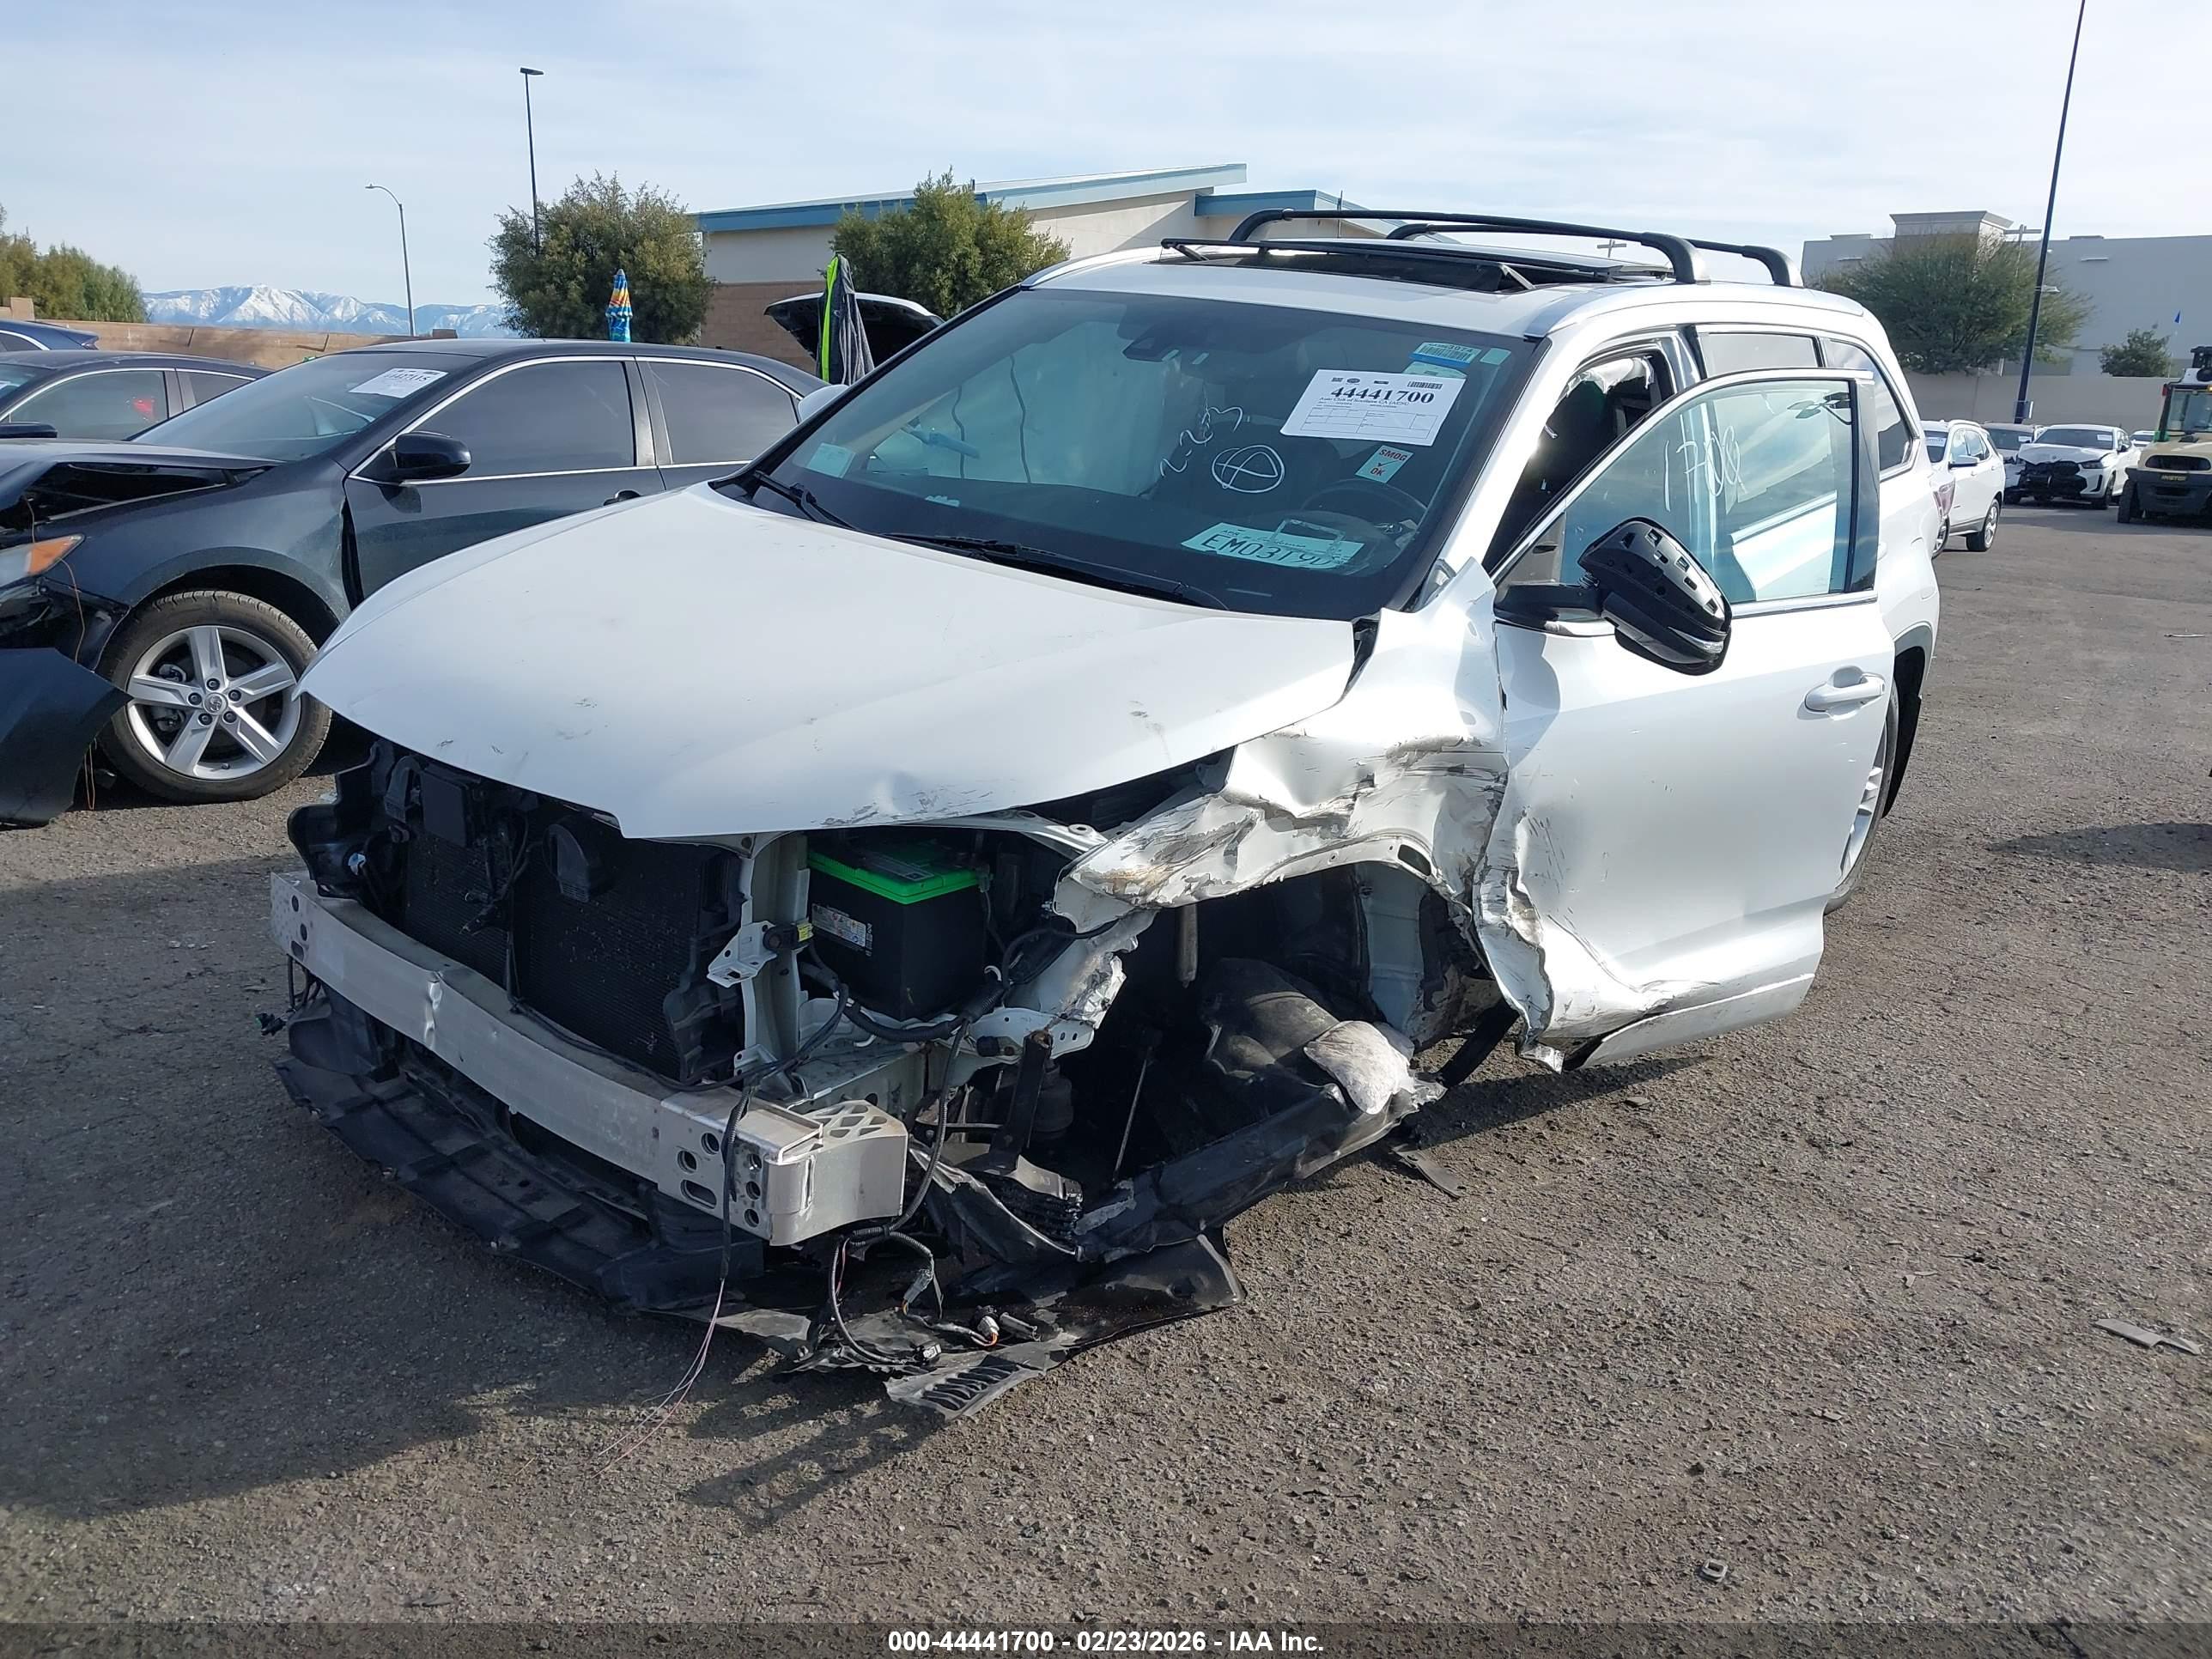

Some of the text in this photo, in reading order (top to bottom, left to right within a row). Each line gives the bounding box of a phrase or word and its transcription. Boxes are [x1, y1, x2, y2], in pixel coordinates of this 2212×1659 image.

[1331, 386, 1435, 404] 44441700
[1379, 449, 1407, 461] SMOG
[1370, 467, 1385, 477] OK
